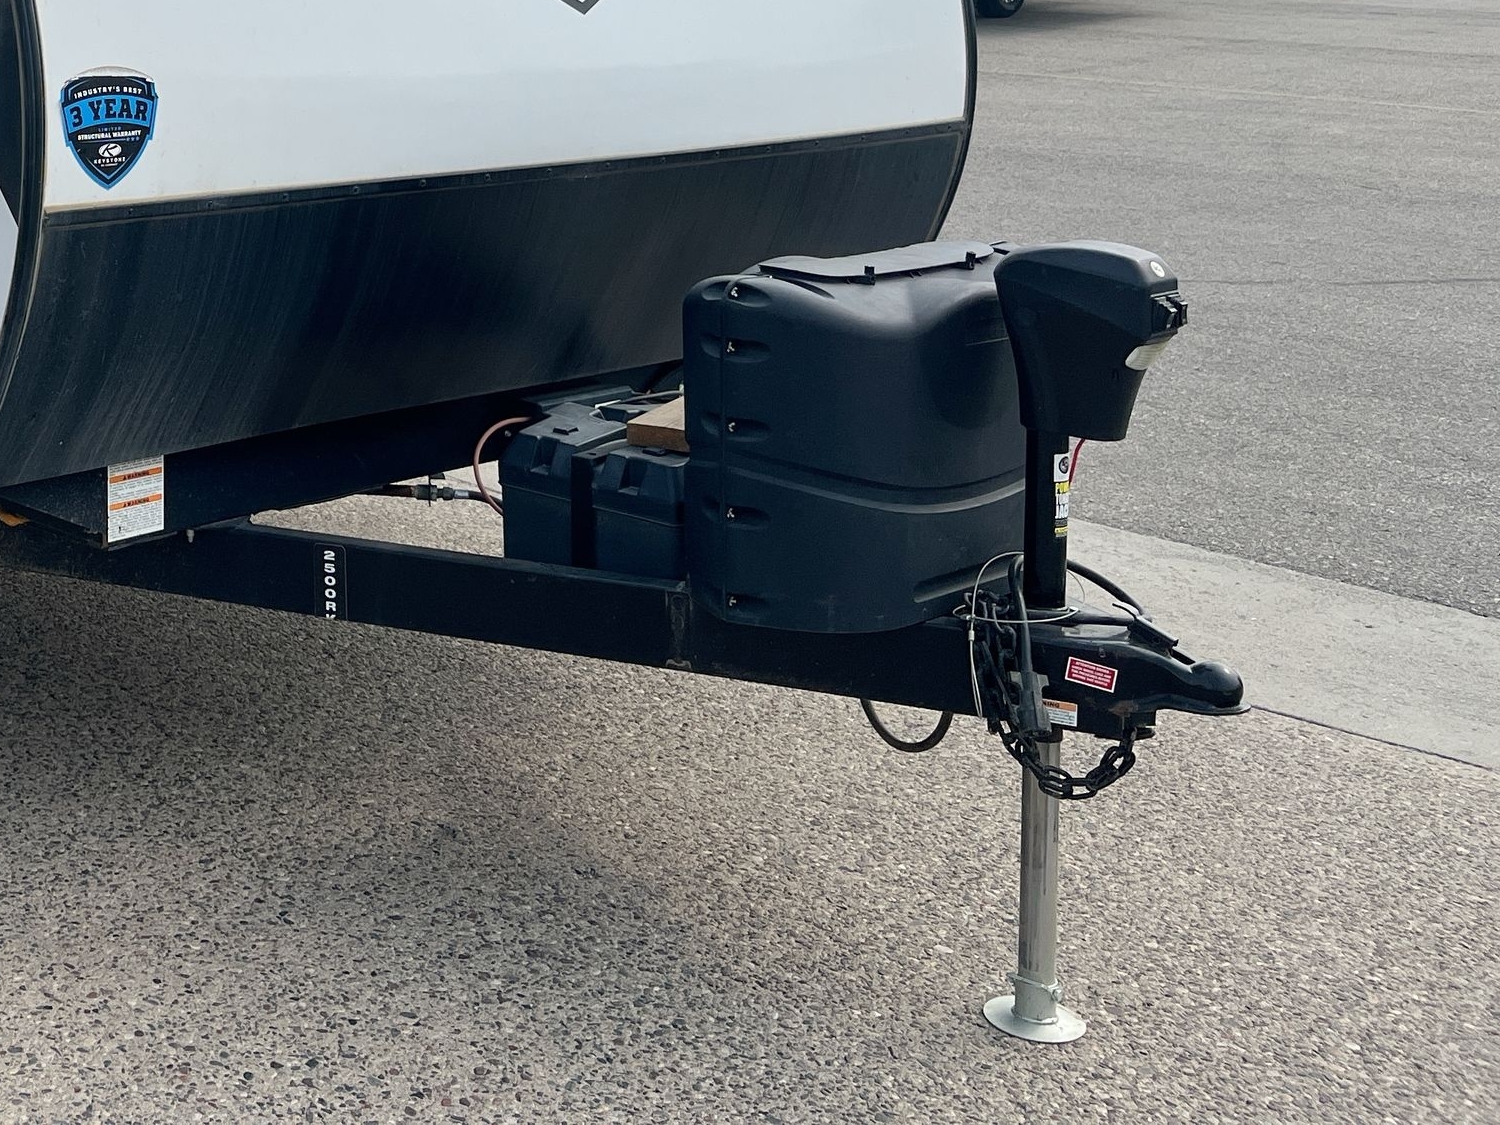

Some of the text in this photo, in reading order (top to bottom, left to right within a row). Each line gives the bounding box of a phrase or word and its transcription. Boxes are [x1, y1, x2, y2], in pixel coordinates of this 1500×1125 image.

[73, 86, 143, 99] INDUSTRY'S BEST
[69, 98, 149, 127] 3 YEAR
[77, 132, 112, 141] STRUCTURAL
[93, 156, 126, 164] KEYSTONE
